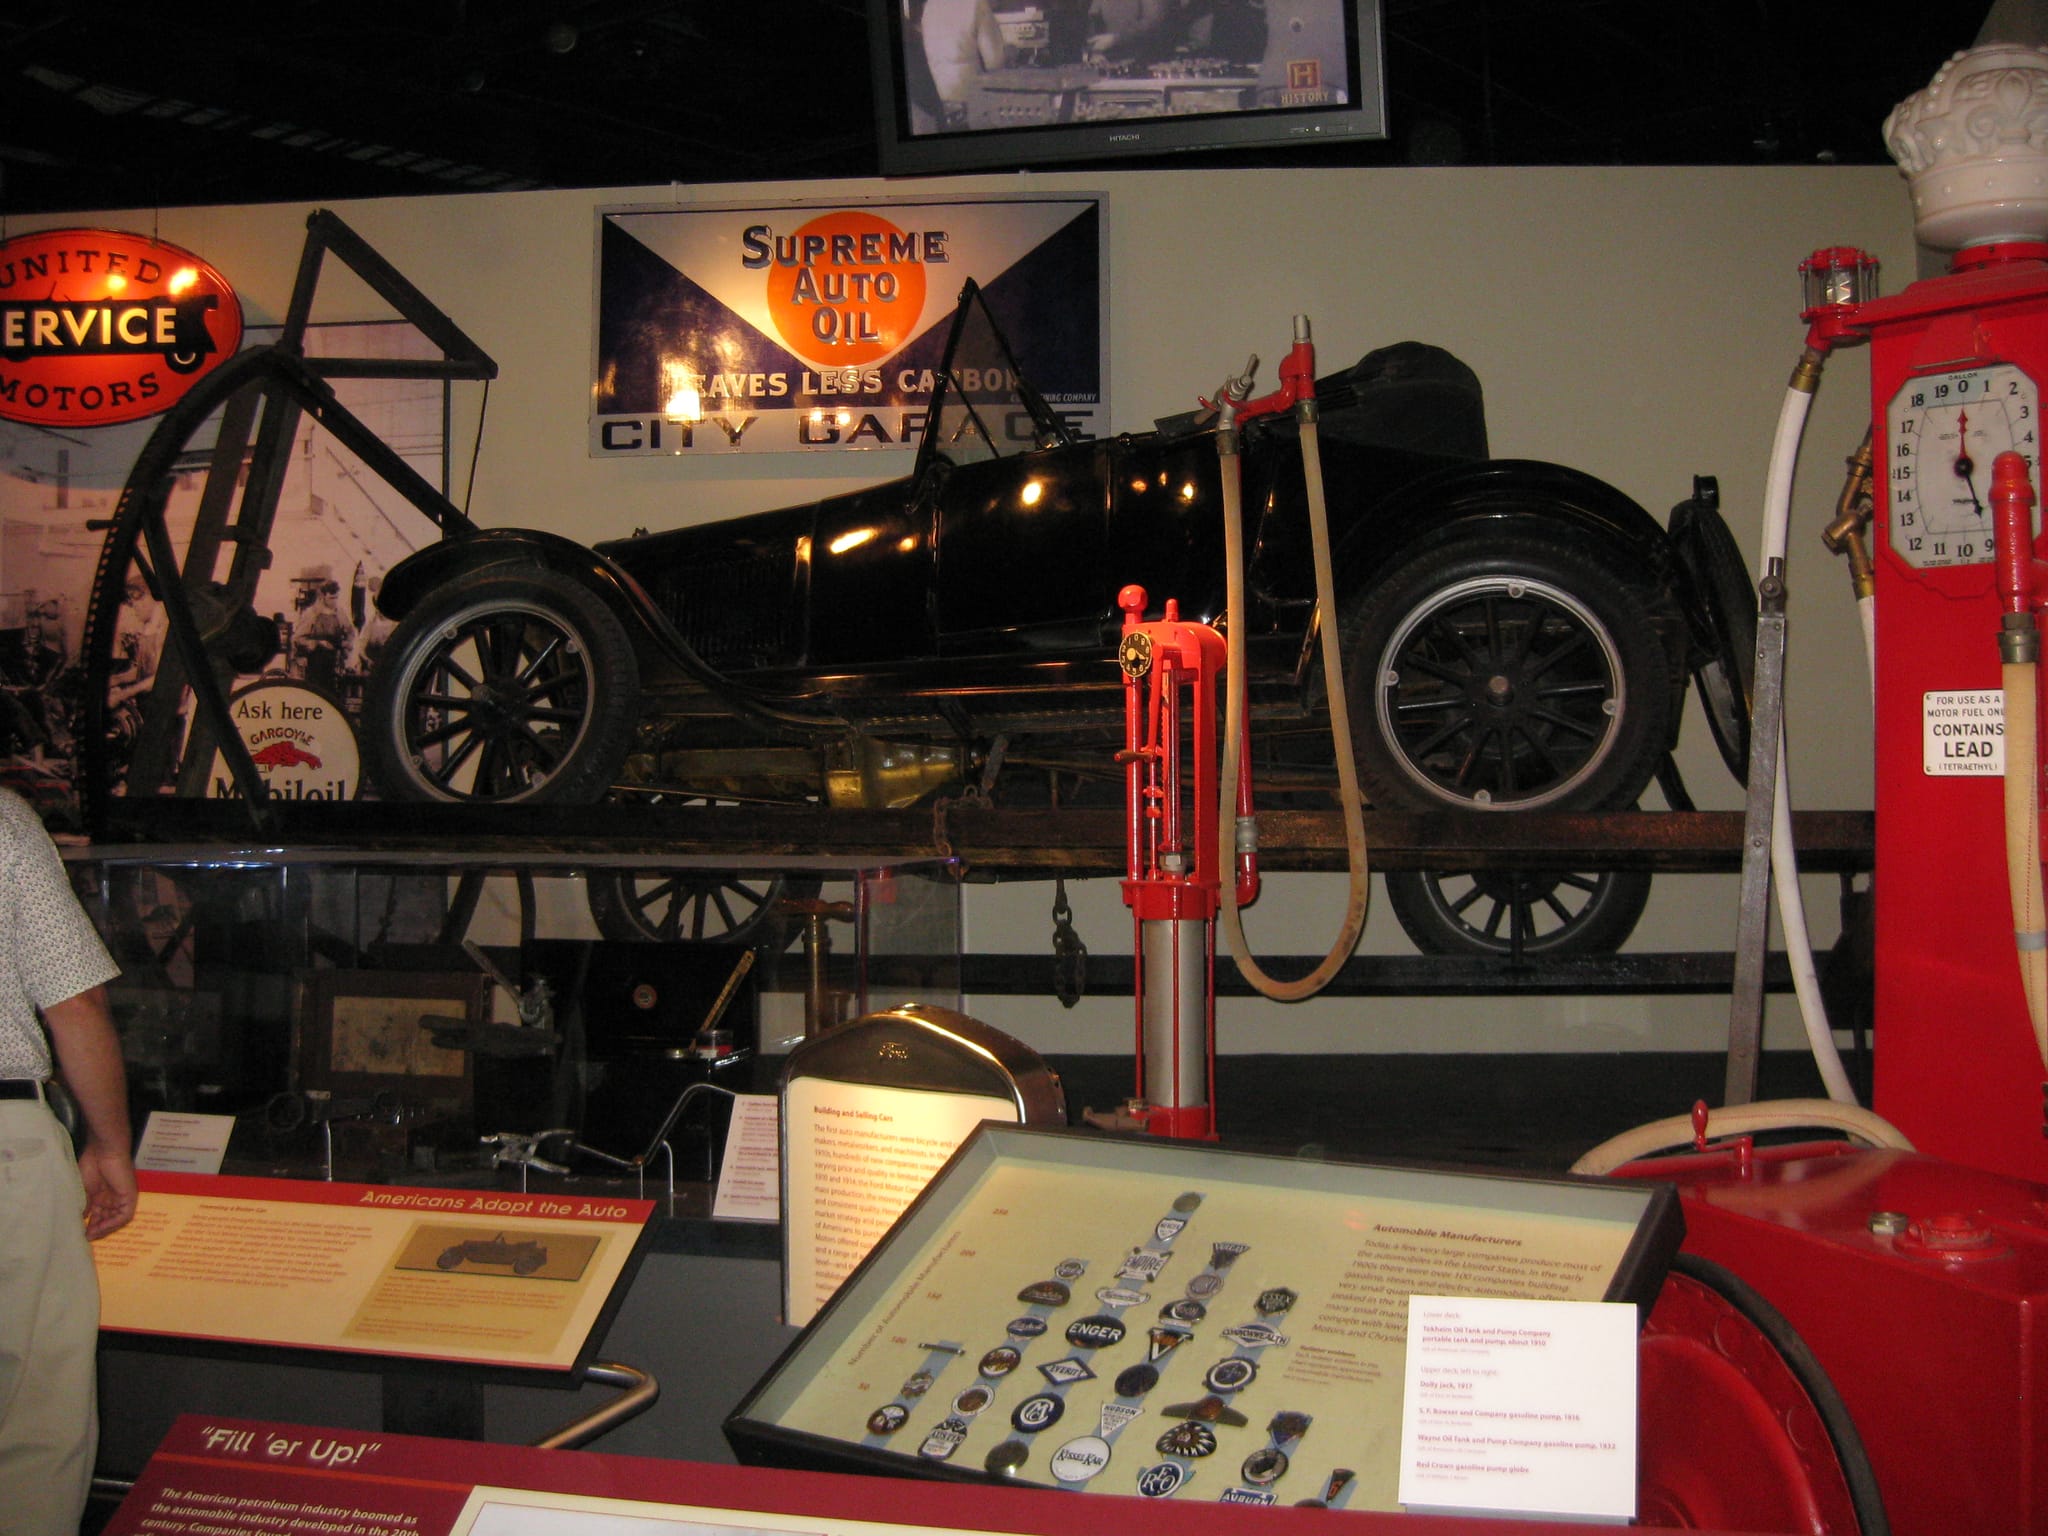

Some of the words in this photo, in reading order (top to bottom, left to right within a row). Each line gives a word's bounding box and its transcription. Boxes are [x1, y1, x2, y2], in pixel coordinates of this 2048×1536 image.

[1281, 91, 1329, 104] HISTORY
[1109, 134, 1140, 142] HITACHI
[742, 225, 950, 269] SUPREME
[0, 250, 162, 289] UNITED
[791, 268, 898, 306] AUTO
[4, 307, 177, 347] ERVICE
[812, 307, 883, 345] OIL
[674, 372, 788, 398] EAVES
[801, 369, 881, 395] LESS
[900, 367, 1021, 393] CABON
[1949, 372, 1978, 381] GALLON
[0, 372, 160, 411] MOTORS
[1935, 385, 1948, 399] 19
[1958, 380, 1968, 392] 0
[1984, 380, 1990, 392] 1
[2009, 382, 2018, 395] 2
[1063, 393, 1097, 402] COMPANY
[1911, 394, 1924, 407] 18
[2020, 407, 2029, 418] 3
[602, 417, 758, 449] CITY
[1901, 420, 1914, 433] 17
[2024, 431, 2034, 442] 4
[1897, 444, 1910, 456] 16
[1896, 467, 1910, 479] 15
[1898, 490, 1911, 502] 14
[1901, 514, 1914, 526] 13
[1909, 537, 1922, 550] 12
[1934, 543, 1946, 555] 11
[1985, 539, 1994, 551] 9
[1958, 544, 1973, 557] 10
[1958, 696, 1975, 704] USE
[1978, 696, 1990, 704] AS
[1994, 695, 2000, 703] A
[237, 699, 272, 718] Ask
[281, 702, 323, 719] here
[1928, 709, 1958, 717] MOTOR
[1962, 708, 1984, 716] FUEL
[1988, 708, 2005, 716] ONL
[1933, 723, 2004, 736] CONTAINS
[250, 727, 315, 746] GARGOYLE
[1944, 742, 1993, 757] LEAD
[1939, 763, 1997, 771] (TETRAETHYL)
[216, 777, 345, 800] Mbiloil
[814, 1106, 840, 1117] Building
[842, 1109, 854, 1118] and
[856, 1111, 878, 1122] Selling
[878, 1113, 893, 1122] Cars
[360, 1191, 465, 1210] Americans
[470, 1197, 533, 1215] Adopt
[539, 1202, 572, 1215] the
[577, 1203, 628, 1218] Auto
[1373, 1224, 1438, 1238] Automobile
[1440, 1231, 1522, 1246] Manufacturers
[1124, 1255, 1162, 1271] EMPIRE
[1441, 1248, 1465, 1257] large
[1468, 1252, 1518, 1263] companies
[1520, 1257, 1562, 1267] produce
[1563, 1262, 1588, 1271] most
[1590, 1264, 1602, 1272] of
[1374, 1253, 1430, 1264] automobiles
[1462, 1261, 1495, 1271] United
[1541, 1270, 1557, 1278] the
[1559, 1273, 1584, 1282] early
[1438, 1282, 1471, 1292] electric
[1473, 1275, 1525, 1286] companies
[1528, 1280, 1568, 1293] building
[1069, 1322, 1122, 1340] ENGER
[1518, 1329, 1551, 1337] Company
[1422, 1335, 1452, 1343] portable
[1420, 1380, 1438, 1389] Dolly
[1103, 1405, 1137, 1415] HUDSON
[1474, 1410, 1507, 1419] Company
[1509, 1412, 1539, 1420] gasoline
[202, 1426, 256, 1453] "Fill
[266, 1432, 302, 1457] 'er
[1418, 1434, 1441, 1443] Wayne
[1442, 1434, 1453, 1442] Oil
[1454, 1435, 1470, 1444] Tank
[1472, 1436, 1485, 1444] and
[1486, 1437, 1507, 1446] Pump
[1509, 1438, 1542, 1448] Company
[1543, 1440, 1573, 1449] gasoline
[1416, 1461, 1430, 1469] Red
[1431, 1462, 1454, 1470] Crown
[1456, 1463, 1485, 1472] gasoline
[1486, 1465, 1508, 1473] pump
[1509, 1465, 1529, 1474] globe
[160, 1488, 182, 1498] The
[184, 1490, 237, 1504] American
[238, 1497, 299, 1512] petroleum
[301, 1502, 351, 1518] industry
[352, 1508, 401, 1524] boomed
[404, 1514, 418, 1525] as
[151, 1502, 170, 1514] the
[171, 1506, 236, 1520] automobile
[238, 1511, 287, 1528] industry
[289, 1518, 351, 1534] developed
[352, 1524, 366, 1534] in
[368, 1525, 389, 1536] the
[189, 1522, 246, 1536] Companies
